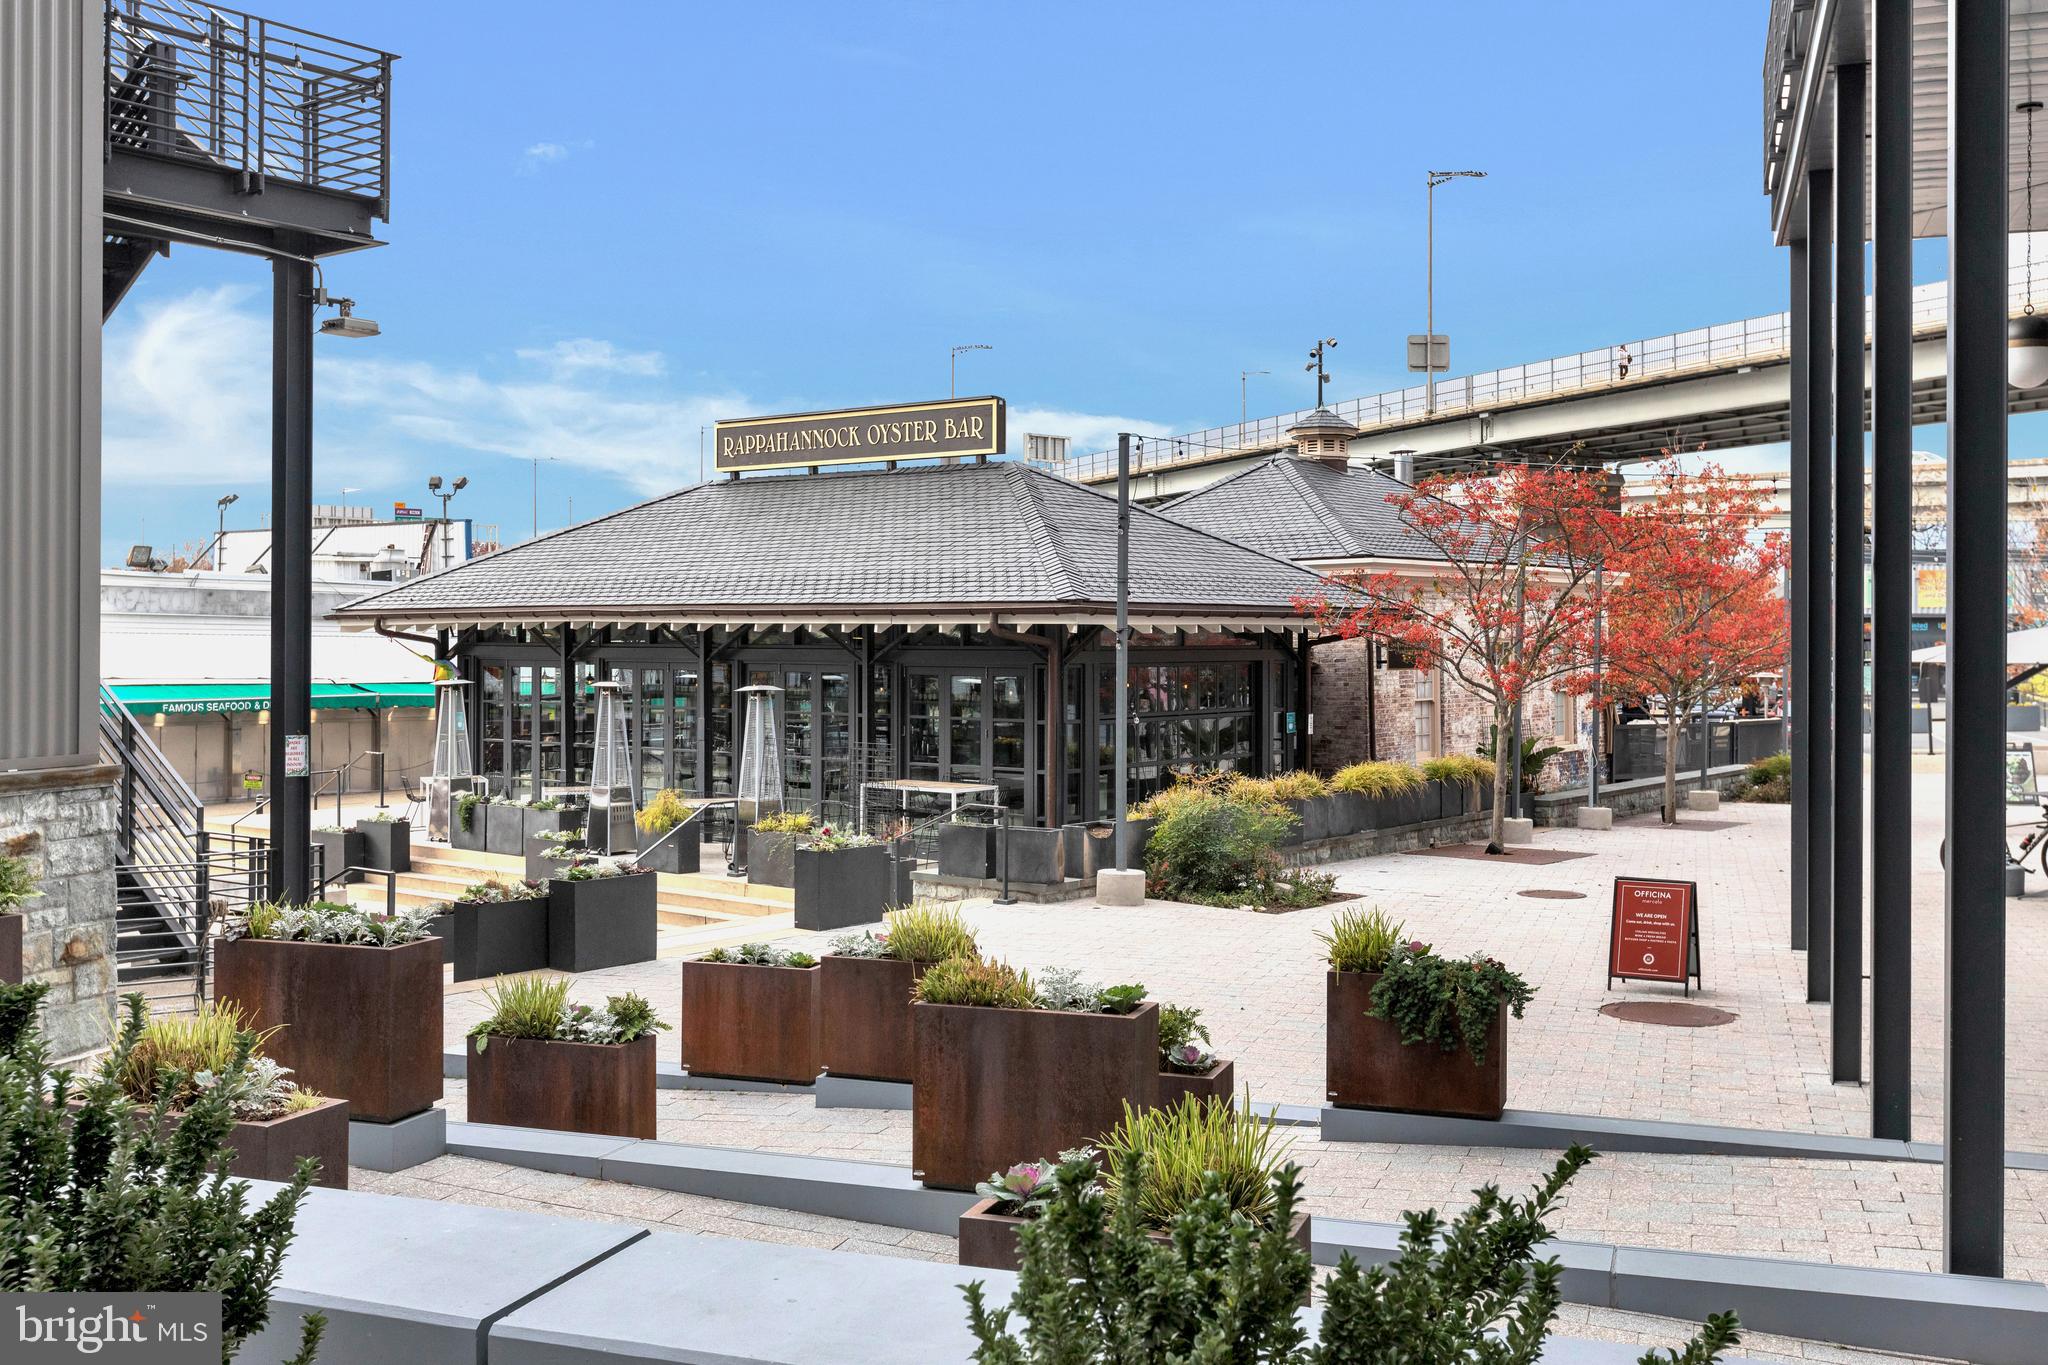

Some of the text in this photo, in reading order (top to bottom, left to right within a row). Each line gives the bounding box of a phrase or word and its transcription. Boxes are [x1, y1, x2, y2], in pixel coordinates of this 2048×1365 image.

[723, 416, 984, 458] RAPPAHANNOCK OYSTER BAR
[162, 702, 204, 713] FAMOUS
[206, 701, 252, 711] SEAFOOD
[254, 701, 261, 710] &
[1634, 890, 1671, 899] OFFICINA
